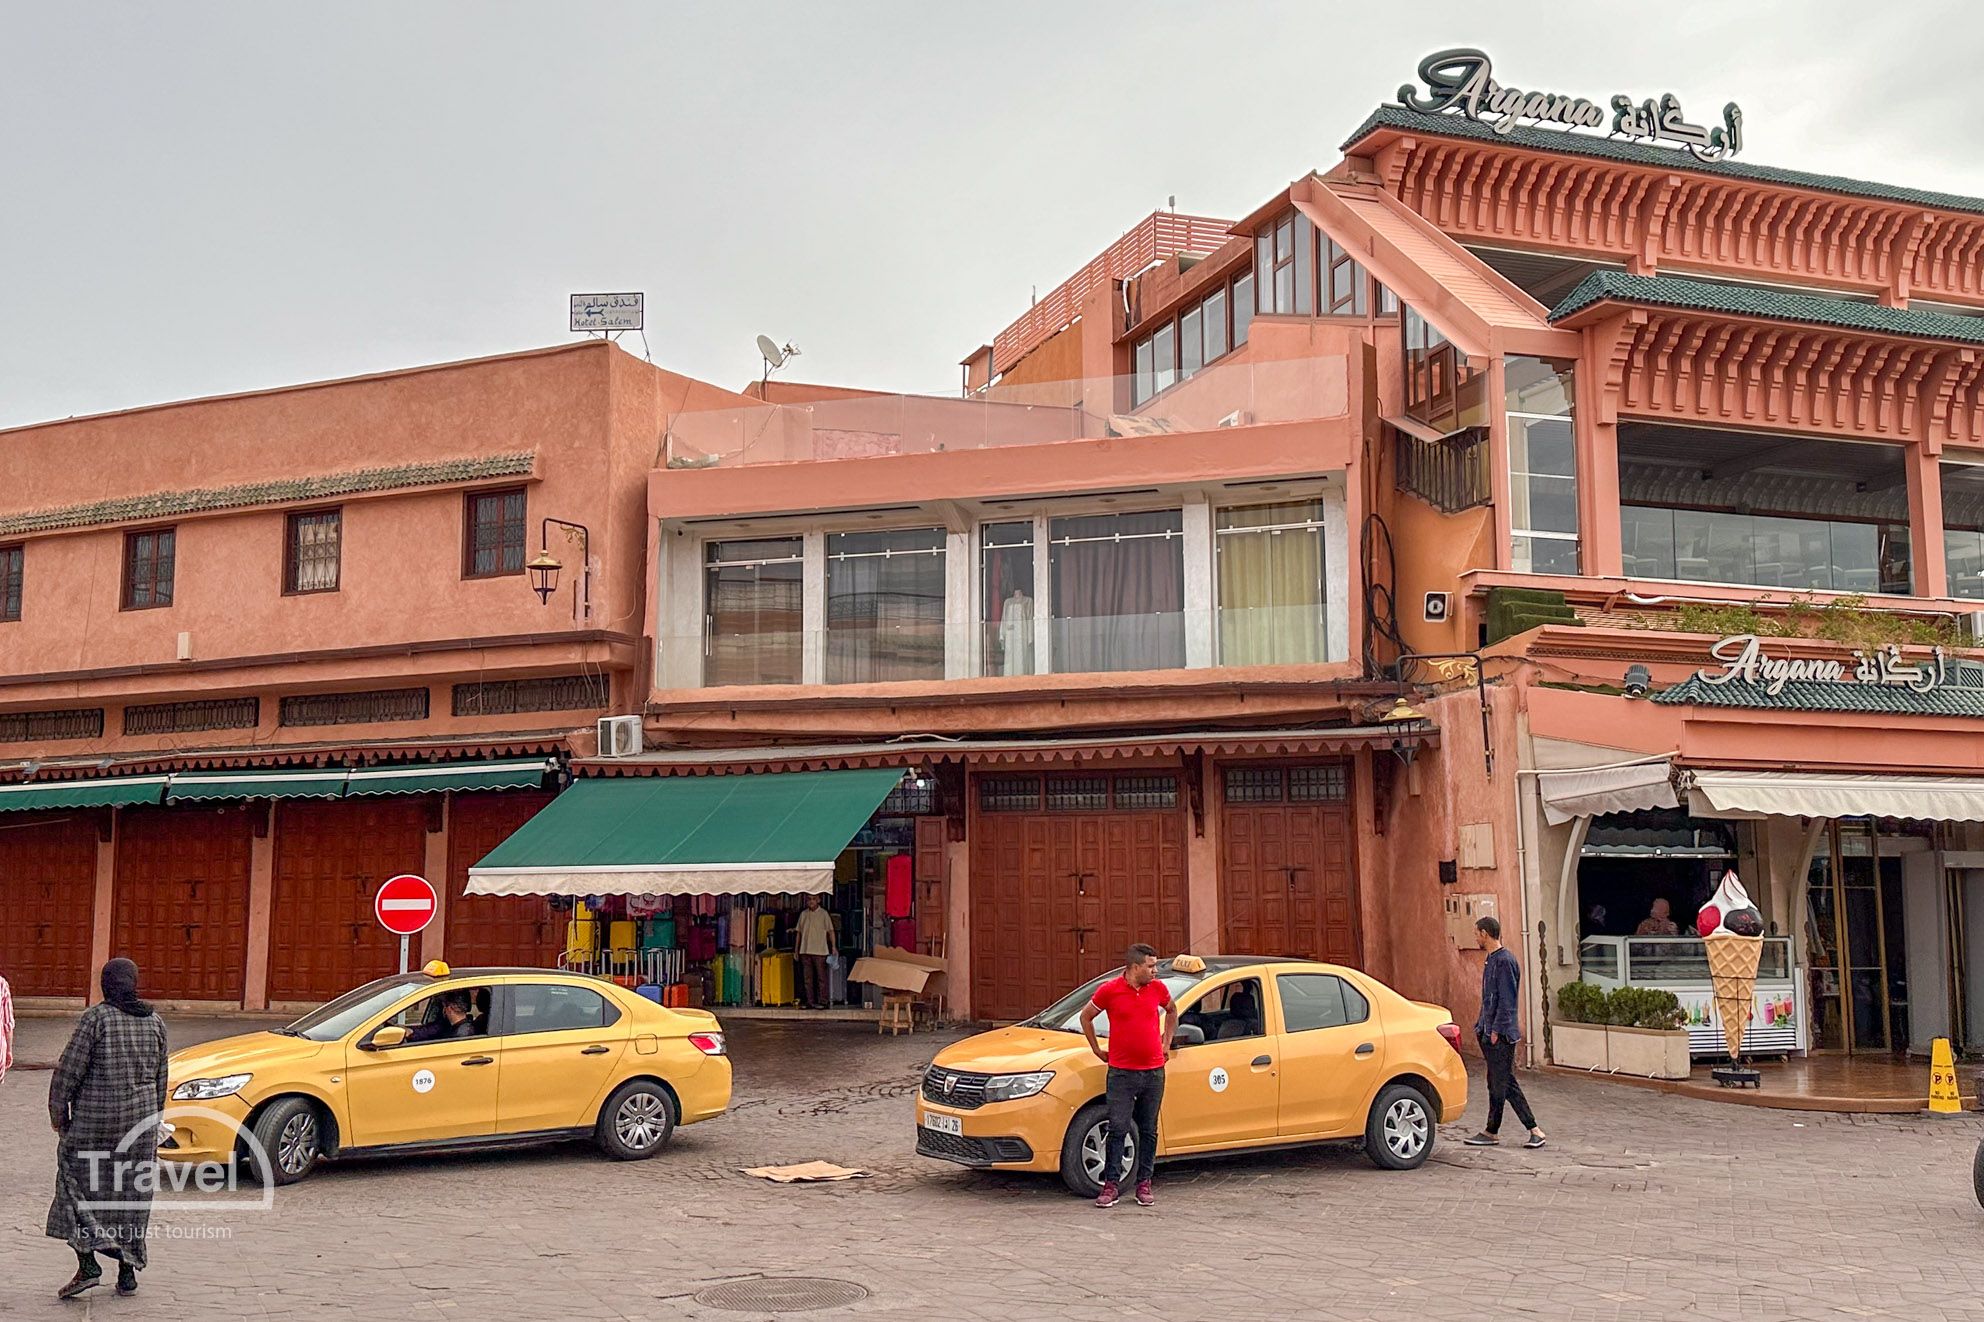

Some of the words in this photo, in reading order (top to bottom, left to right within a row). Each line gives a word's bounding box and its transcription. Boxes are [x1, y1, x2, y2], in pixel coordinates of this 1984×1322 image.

[1399, 49, 1603, 135] Argana
[610, 296, 639, 308] فندق
[574, 317, 596, 327] Hotel
[600, 317, 632, 326] Salem
[1698, 633, 1845, 696] Argana
[1212, 1074, 1226, 1085] 305
